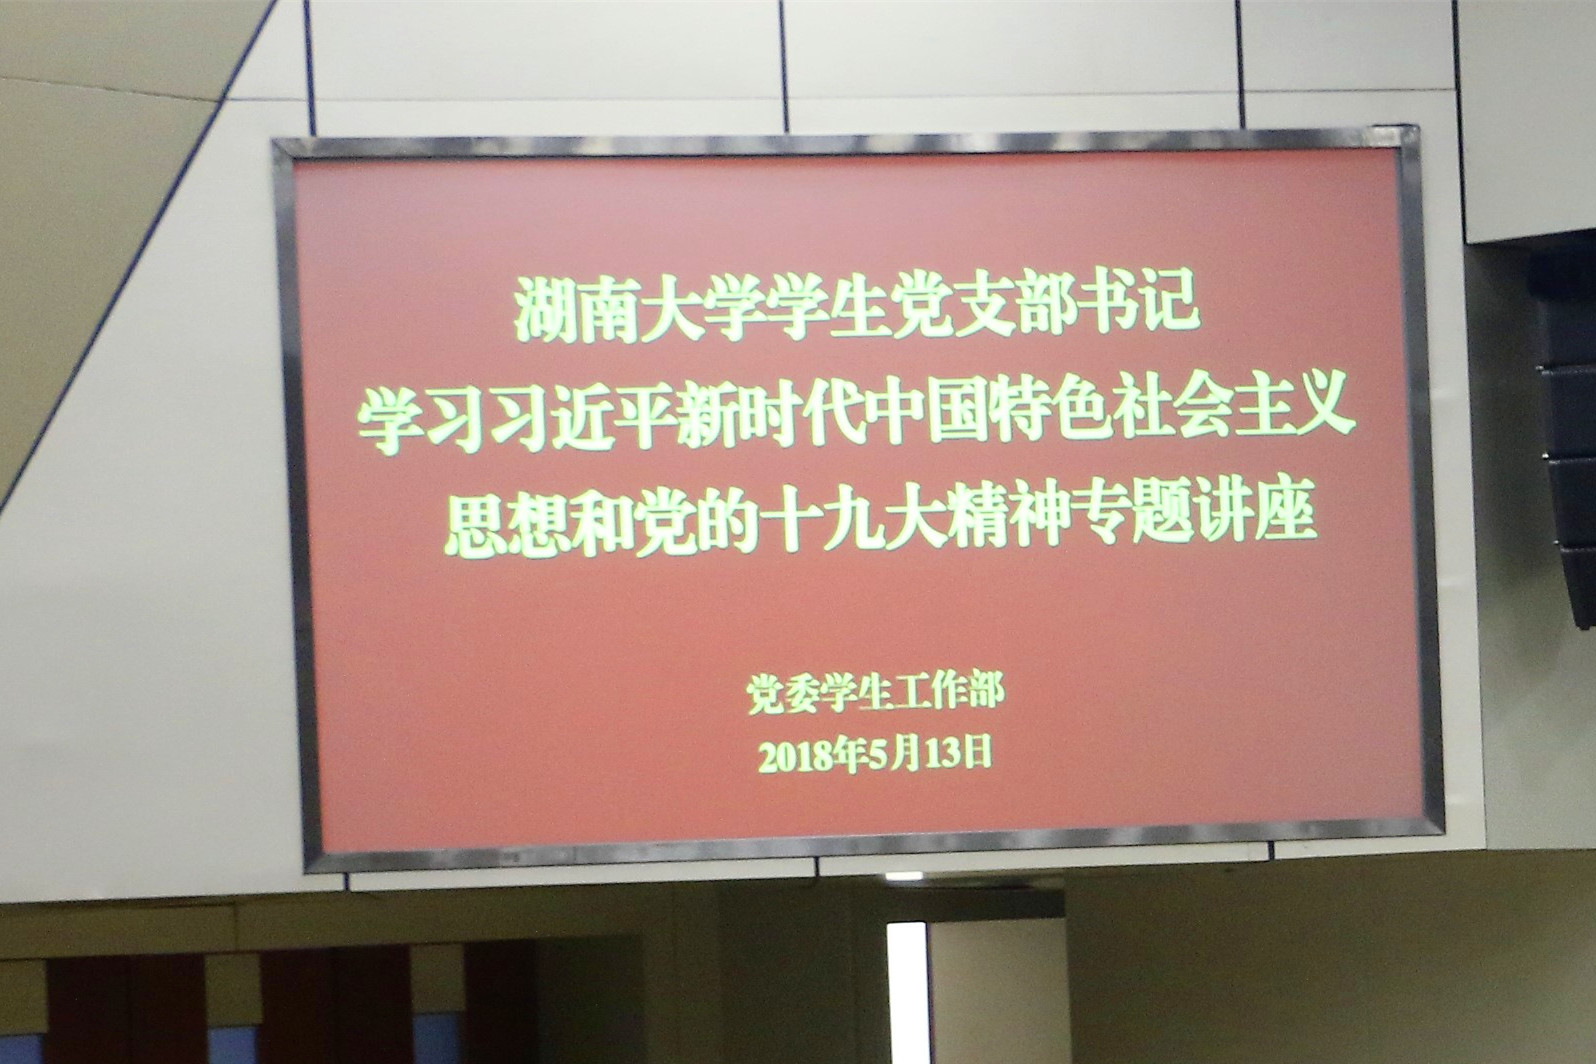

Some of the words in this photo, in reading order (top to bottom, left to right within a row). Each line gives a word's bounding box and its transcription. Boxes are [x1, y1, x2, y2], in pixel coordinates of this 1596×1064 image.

[514, 265, 1203, 345] 湖南大学学生党支部书记
[356, 367, 1358, 457] 学习习近平新时代中国特色社会主义
[443, 471, 1320, 562] 思想和党的十九大精神专题讲座
[746, 668, 1006, 716] 党委学生工作部
[758, 733, 993, 775] 2018年5月13日
